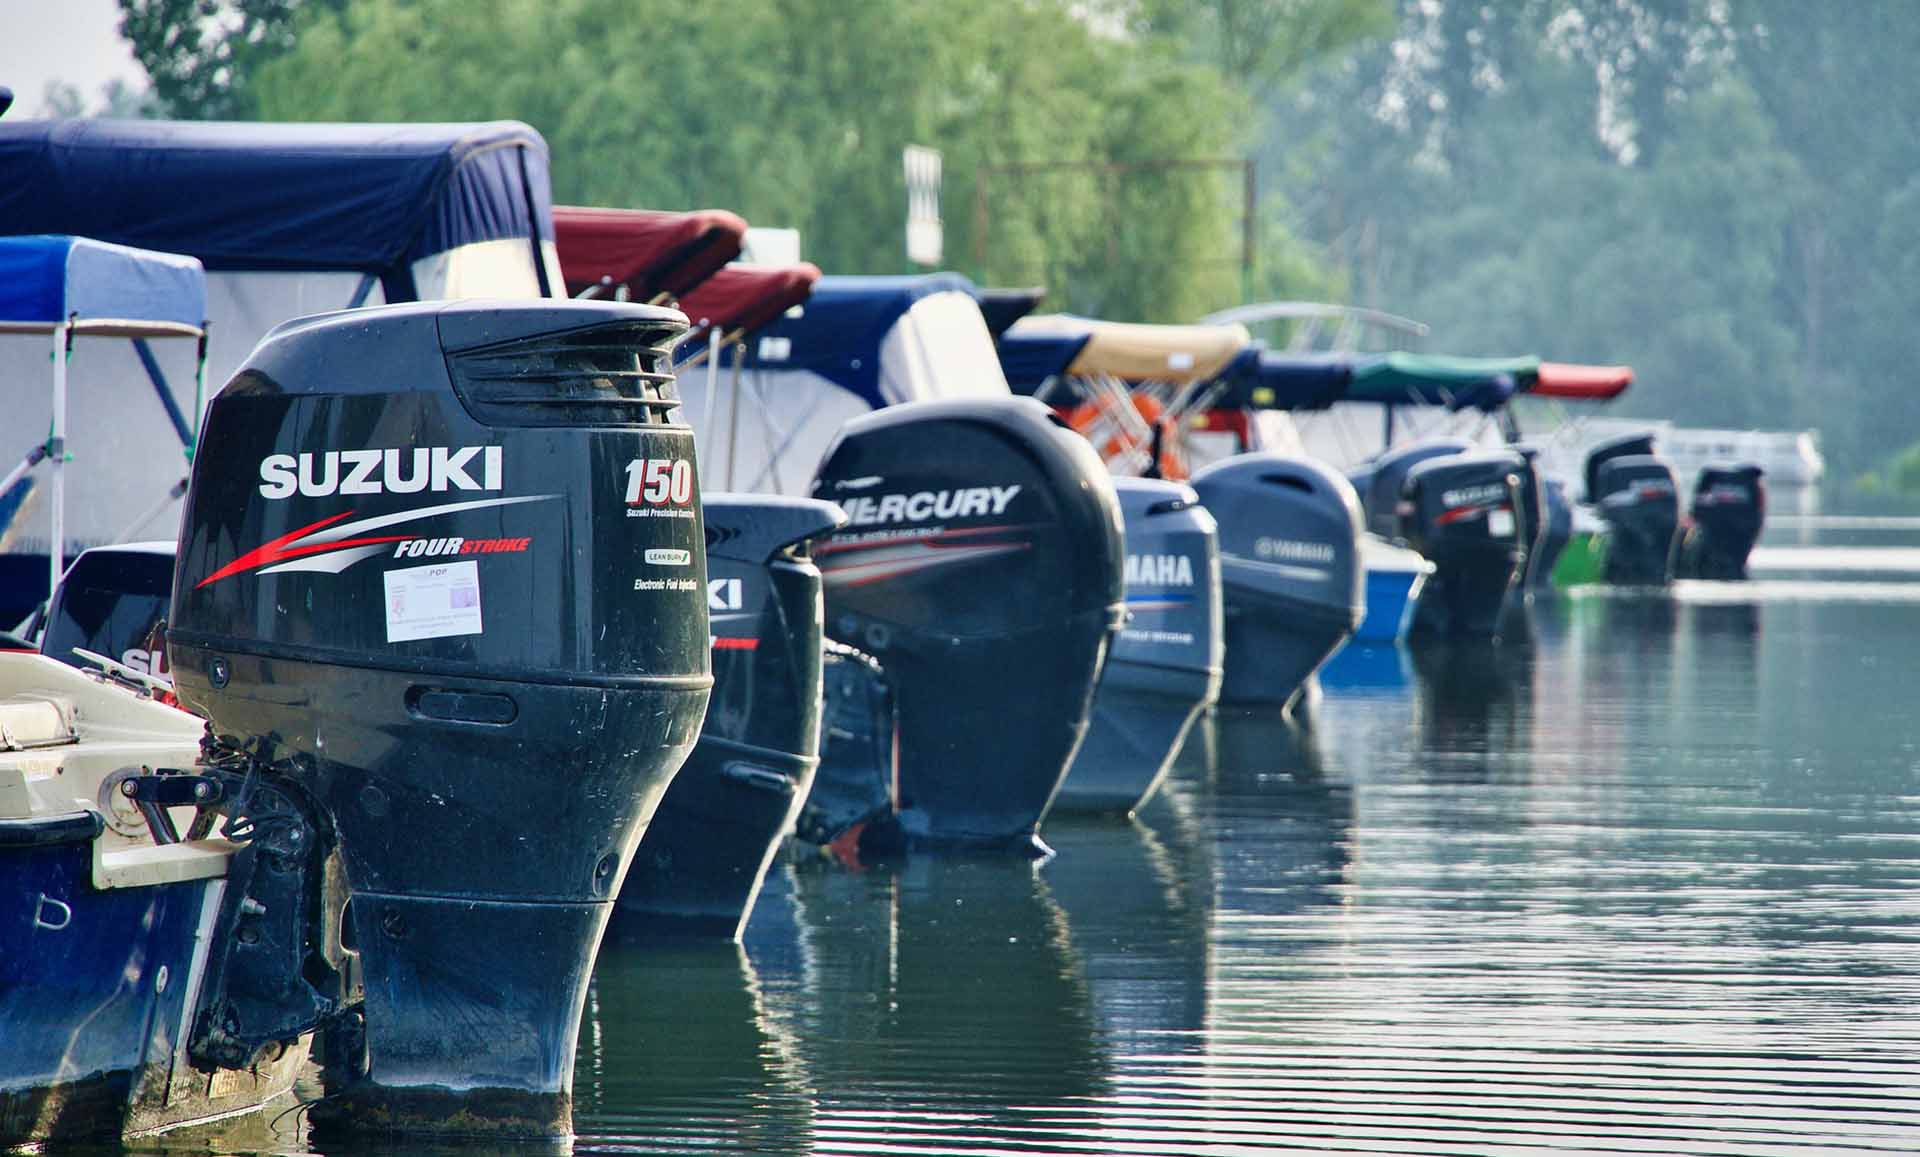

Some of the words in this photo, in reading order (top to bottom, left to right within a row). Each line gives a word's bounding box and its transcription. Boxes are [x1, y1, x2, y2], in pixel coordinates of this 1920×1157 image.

[259, 446, 502, 500] SUZUKI
[625, 458, 693, 506] 150
[626, 508, 650, 518] Suzuki
[649, 553, 666, 561] LEAN
[633, 578, 666, 590] Electronic
